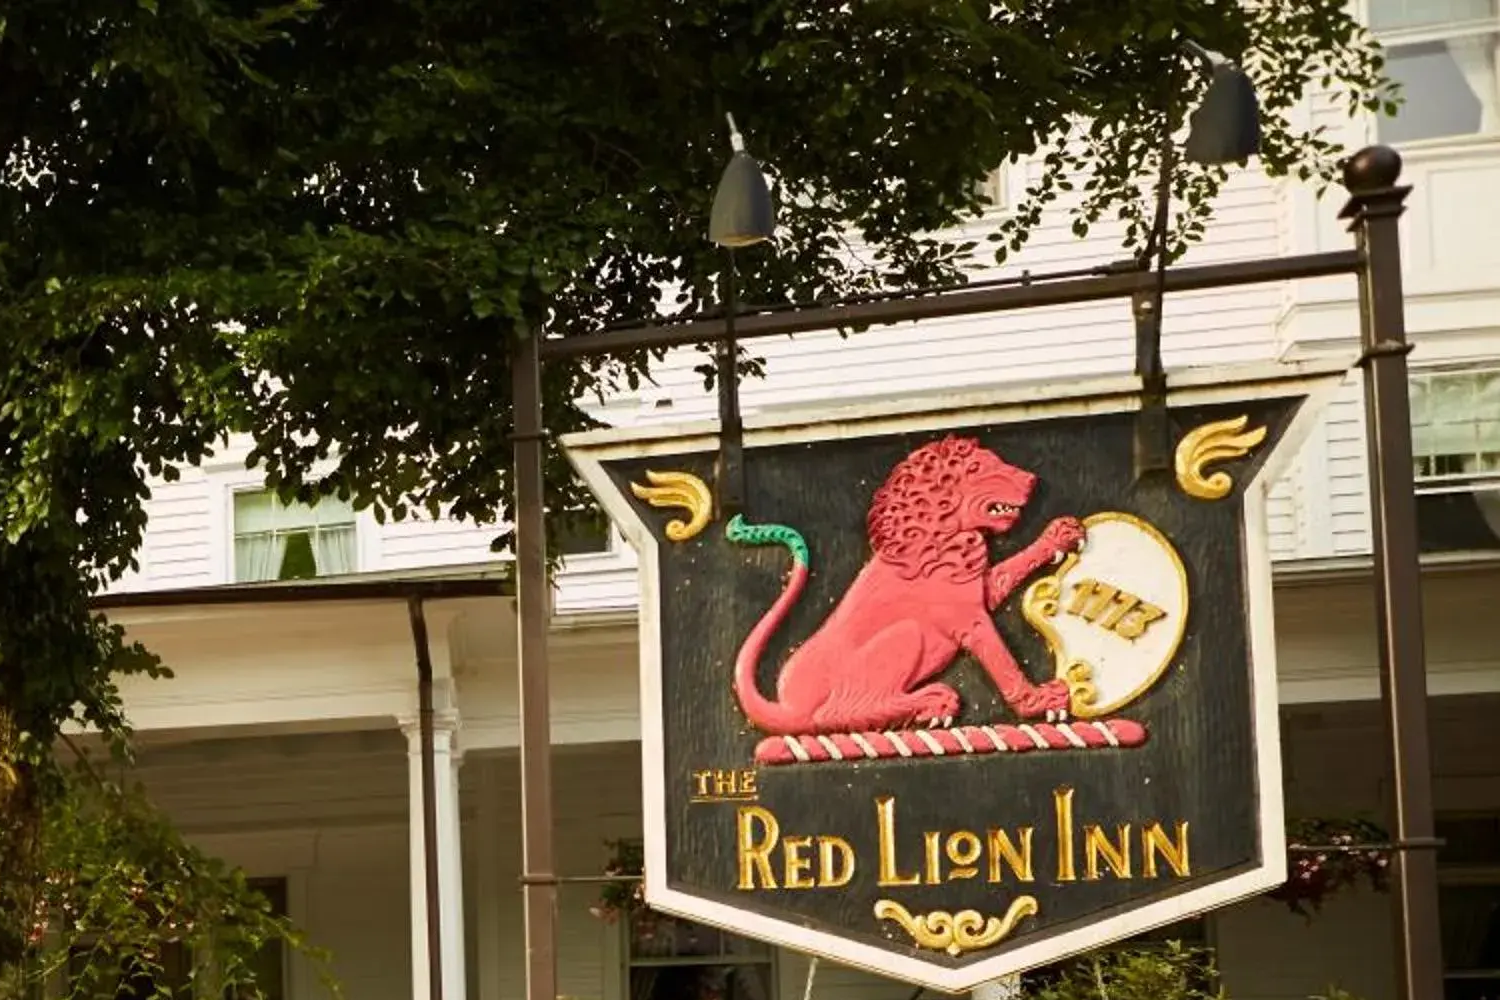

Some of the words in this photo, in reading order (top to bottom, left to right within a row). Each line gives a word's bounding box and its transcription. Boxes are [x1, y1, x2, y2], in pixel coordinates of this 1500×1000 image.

[693, 770, 758, 796] THE
[737, 804, 856, 890] RED
[875, 796, 1035, 887] LION
[1052, 784, 1191, 881] INN
